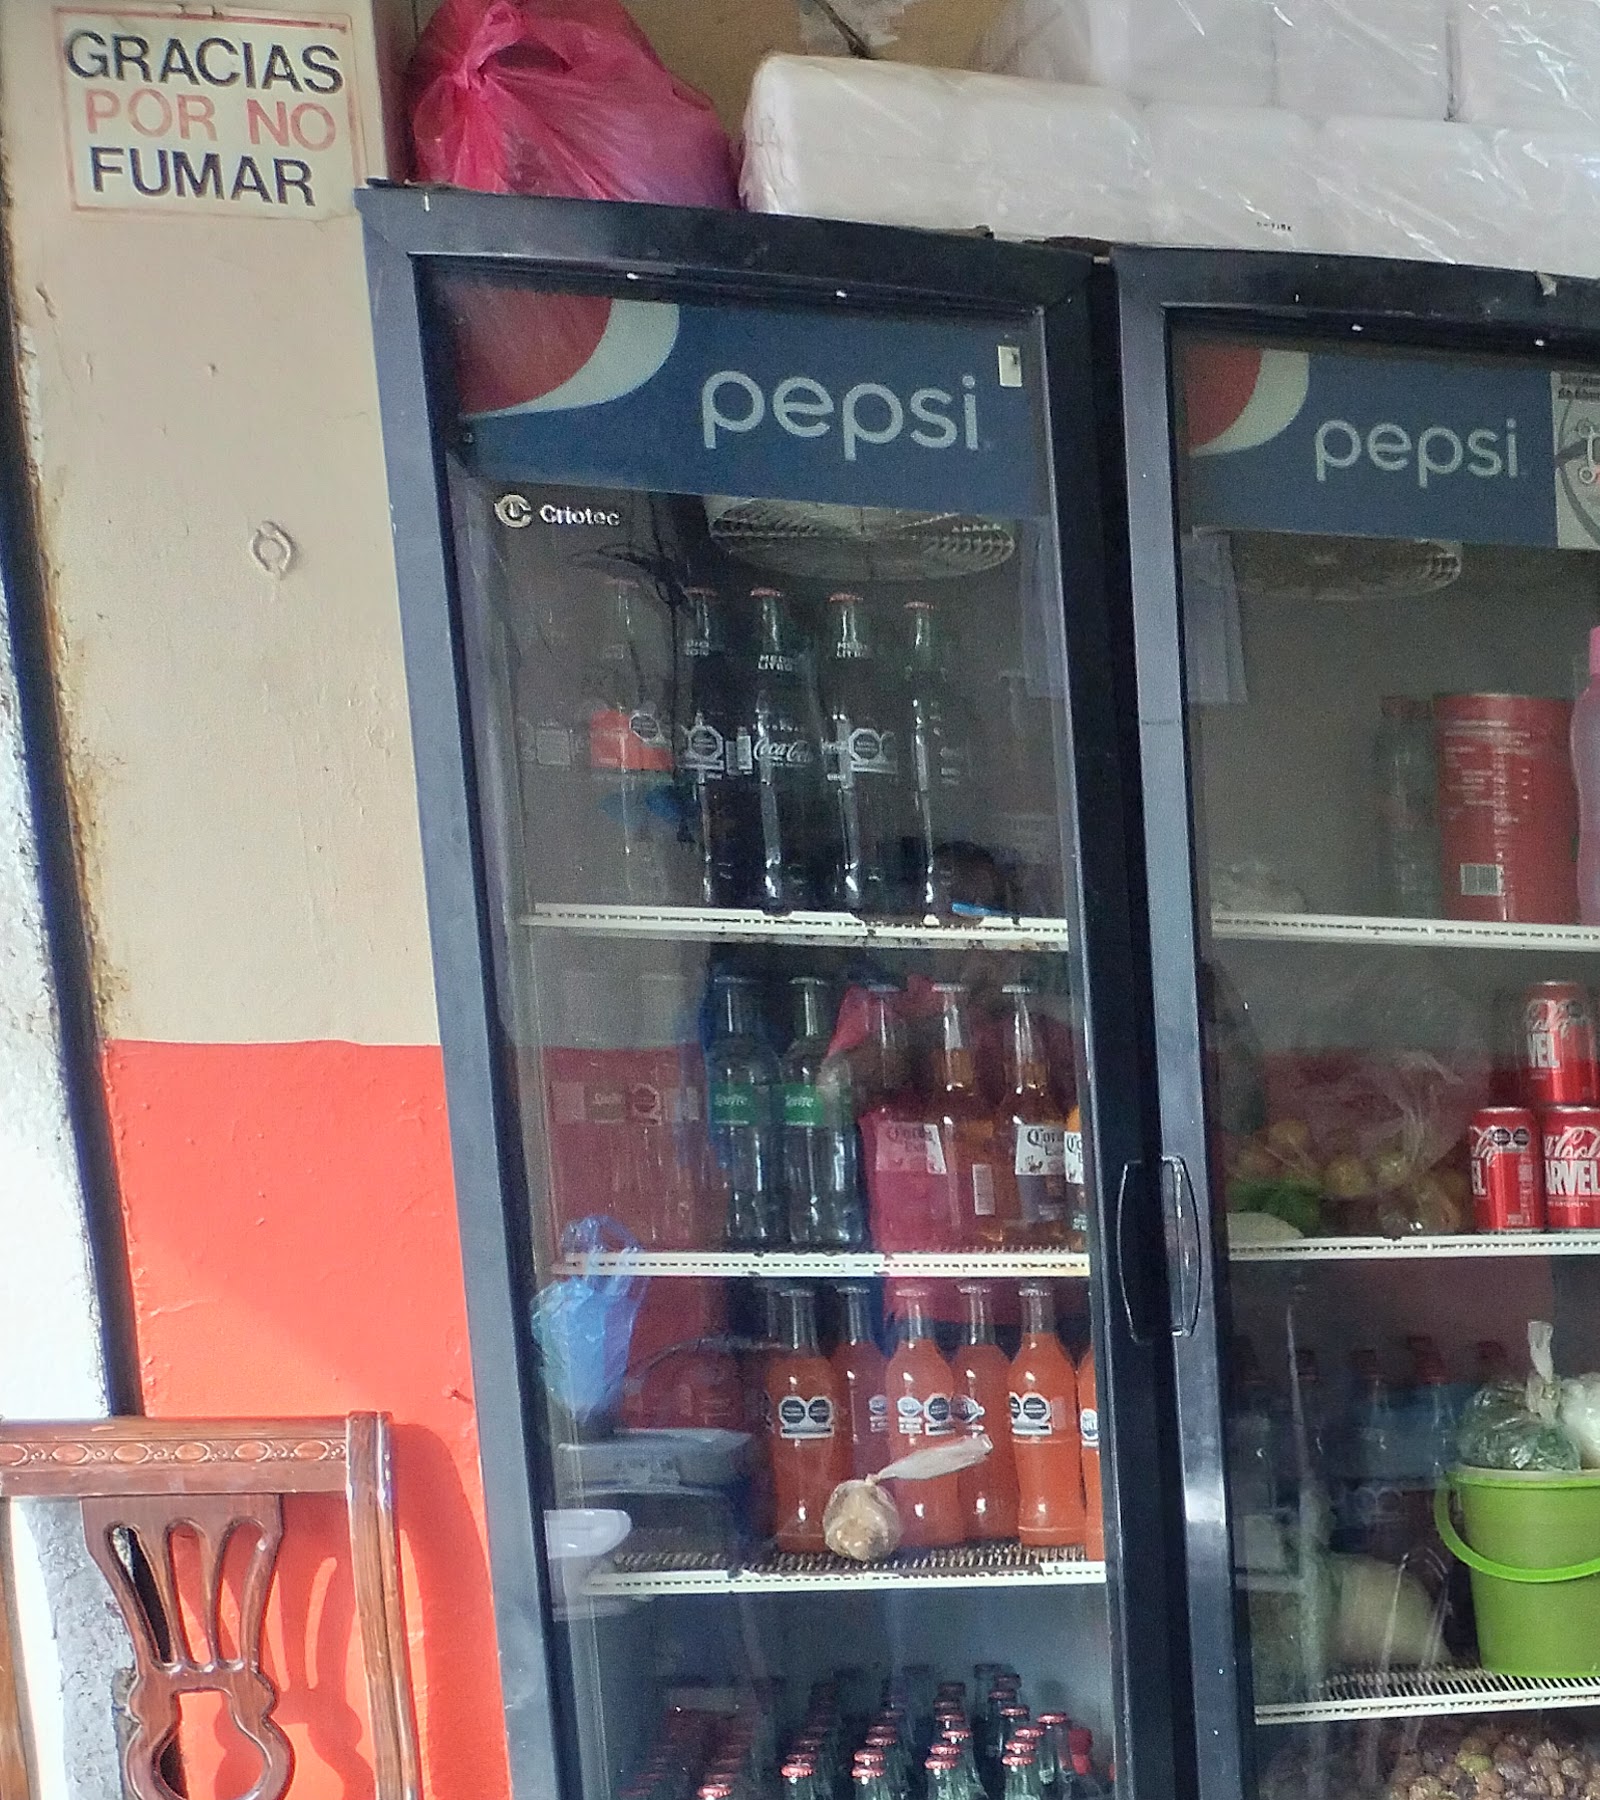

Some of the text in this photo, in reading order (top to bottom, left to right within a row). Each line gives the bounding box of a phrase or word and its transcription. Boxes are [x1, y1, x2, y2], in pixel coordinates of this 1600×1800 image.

[65, 30, 344, 95] GRACIAS
[85, 88, 336, 151] POR NO
[90, 146, 316, 207] FUMAR
[701, 369, 979, 461] pepsi
[1314, 417, 1520, 488] pepsi
[539, 503, 621, 528] Criotec
